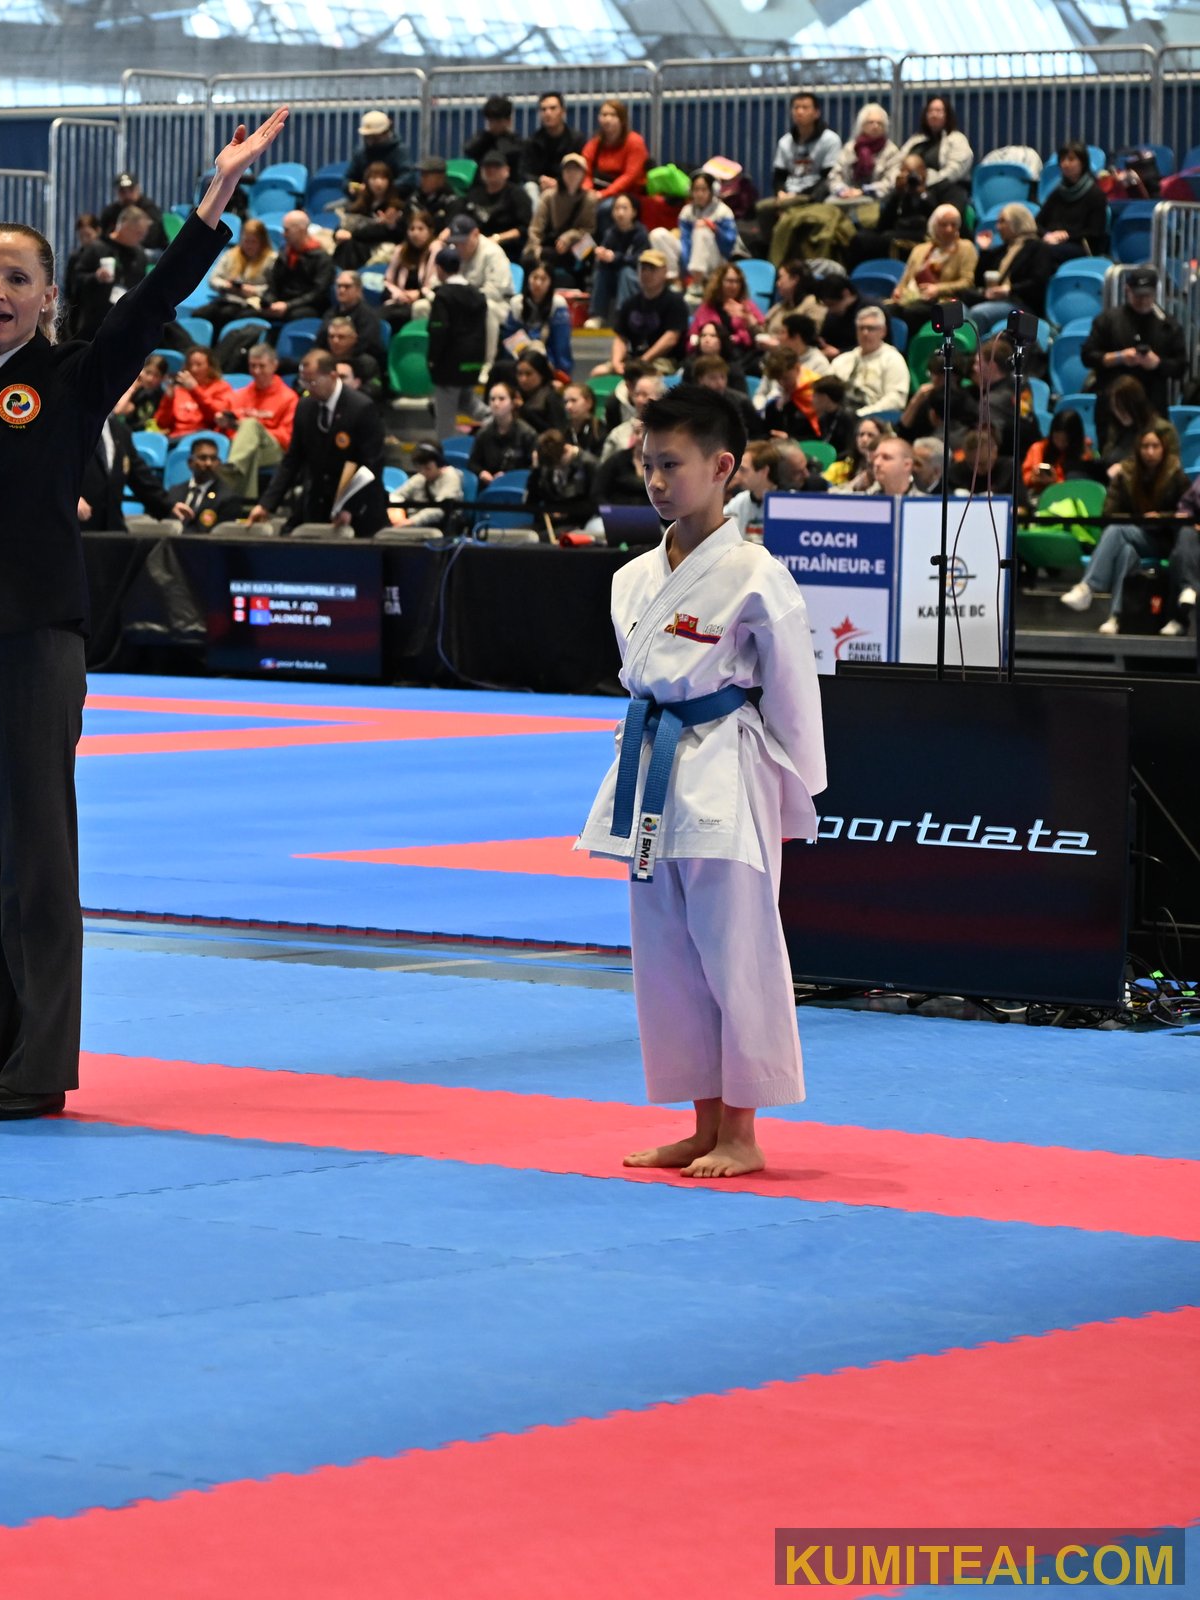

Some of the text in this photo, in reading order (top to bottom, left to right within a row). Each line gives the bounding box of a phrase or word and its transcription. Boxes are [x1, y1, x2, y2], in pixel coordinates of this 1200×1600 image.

[799, 531, 858, 548] COACH
[774, 553, 886, 575] NTRAÎNEUR·E
[970, 604, 986, 617] BC
[848, 642, 882, 652] KARATE
[806, 812, 1097, 856] portdata
